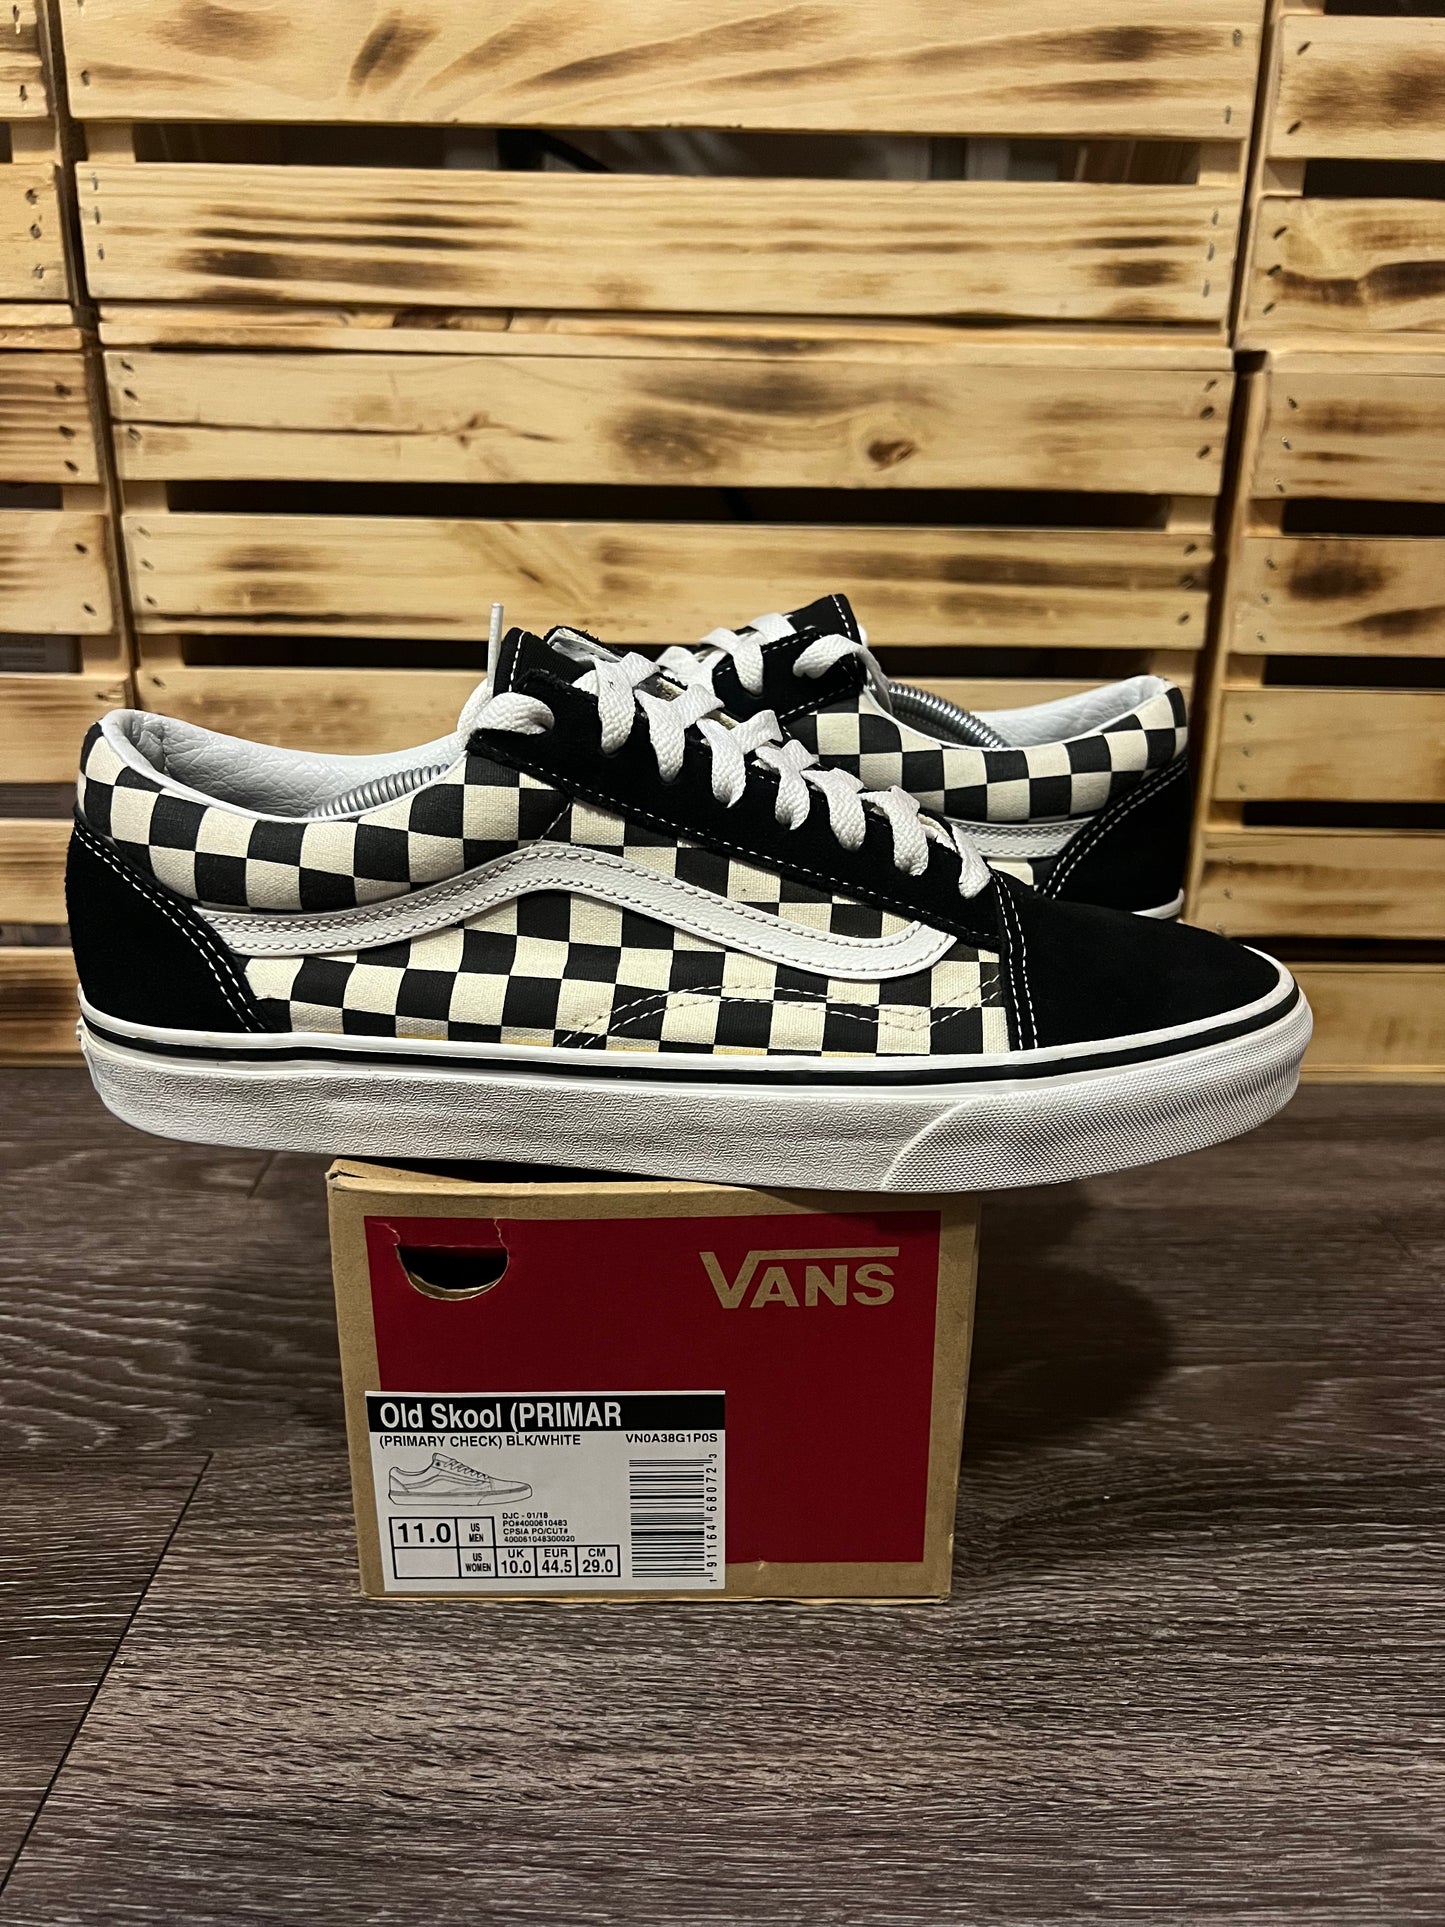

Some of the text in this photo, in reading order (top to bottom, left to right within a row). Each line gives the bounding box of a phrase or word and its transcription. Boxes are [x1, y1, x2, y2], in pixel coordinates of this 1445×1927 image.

[699, 1246, 900, 1309] VANS
[379, 1402, 622, 1433] Old Skool (PRIMAR
[379, 1434, 581, 1450] (PRIMARY CHECK) BLK/WHITE
[705, 1467, 718, 1512] 68072
[502, 1512, 520, 1520] DJC
[397, 1522, 452, 1543] 11.0
[470, 1523, 481, 1532] US
[503, 1527, 569, 1535] CPSIA PO/CUT#
[468, 1533, 484, 1543] MEN
[706, 1524, 718, 1567] 91164
[472, 1552, 483, 1562] US
[507, 1549, 525, 1558] UK
[544, 1548, 569, 1558] EUR
[588, 1548, 606, 1557] CM
[465, 1562, 492, 1572] WOMEN
[501, 1560, 532, 1574] 10.0
[541, 1559, 573, 1573] 44.5
[582, 1559, 614, 1573] 29.0
